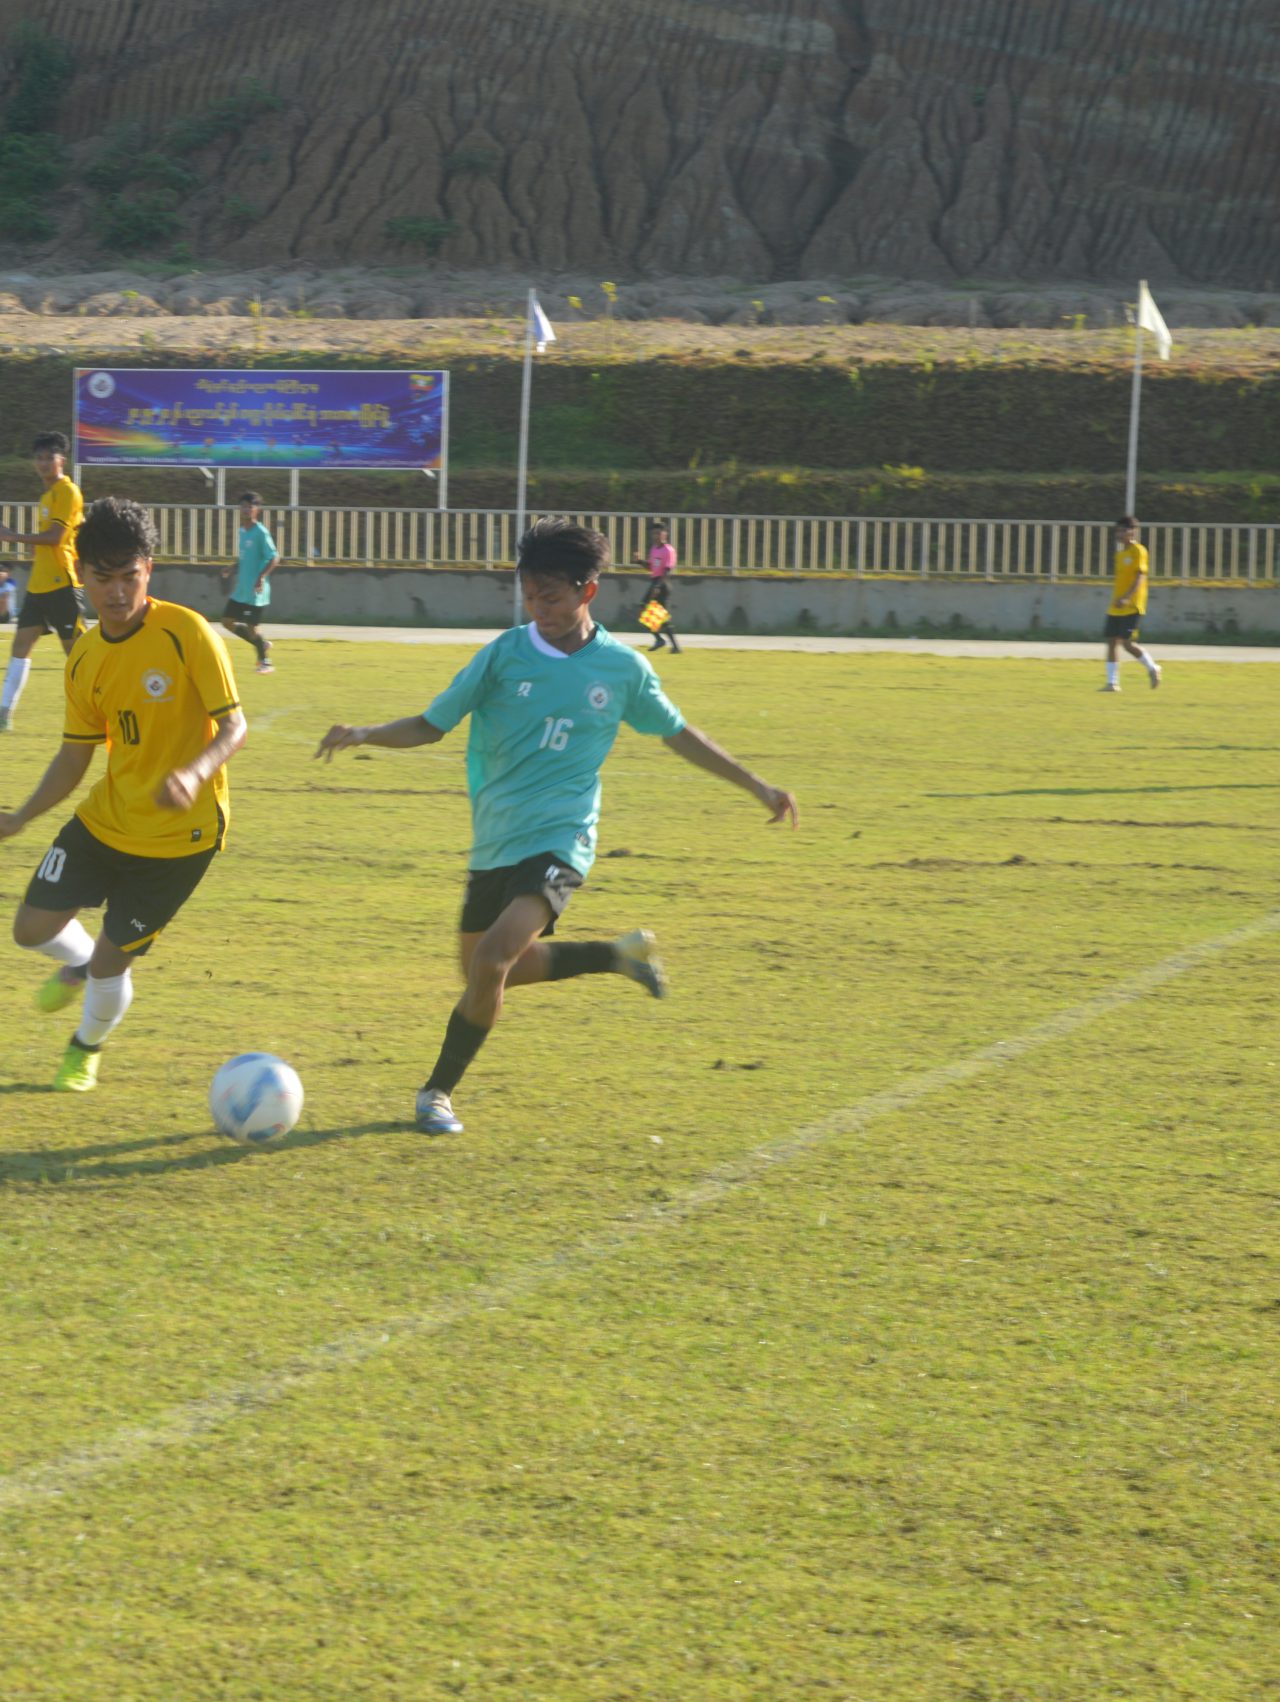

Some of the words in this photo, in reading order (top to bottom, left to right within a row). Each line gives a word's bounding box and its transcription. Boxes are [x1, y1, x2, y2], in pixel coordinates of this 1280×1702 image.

[117, 709, 140, 745] 10
[539, 716, 574, 751] 16
[37, 846, 68, 883] 10
